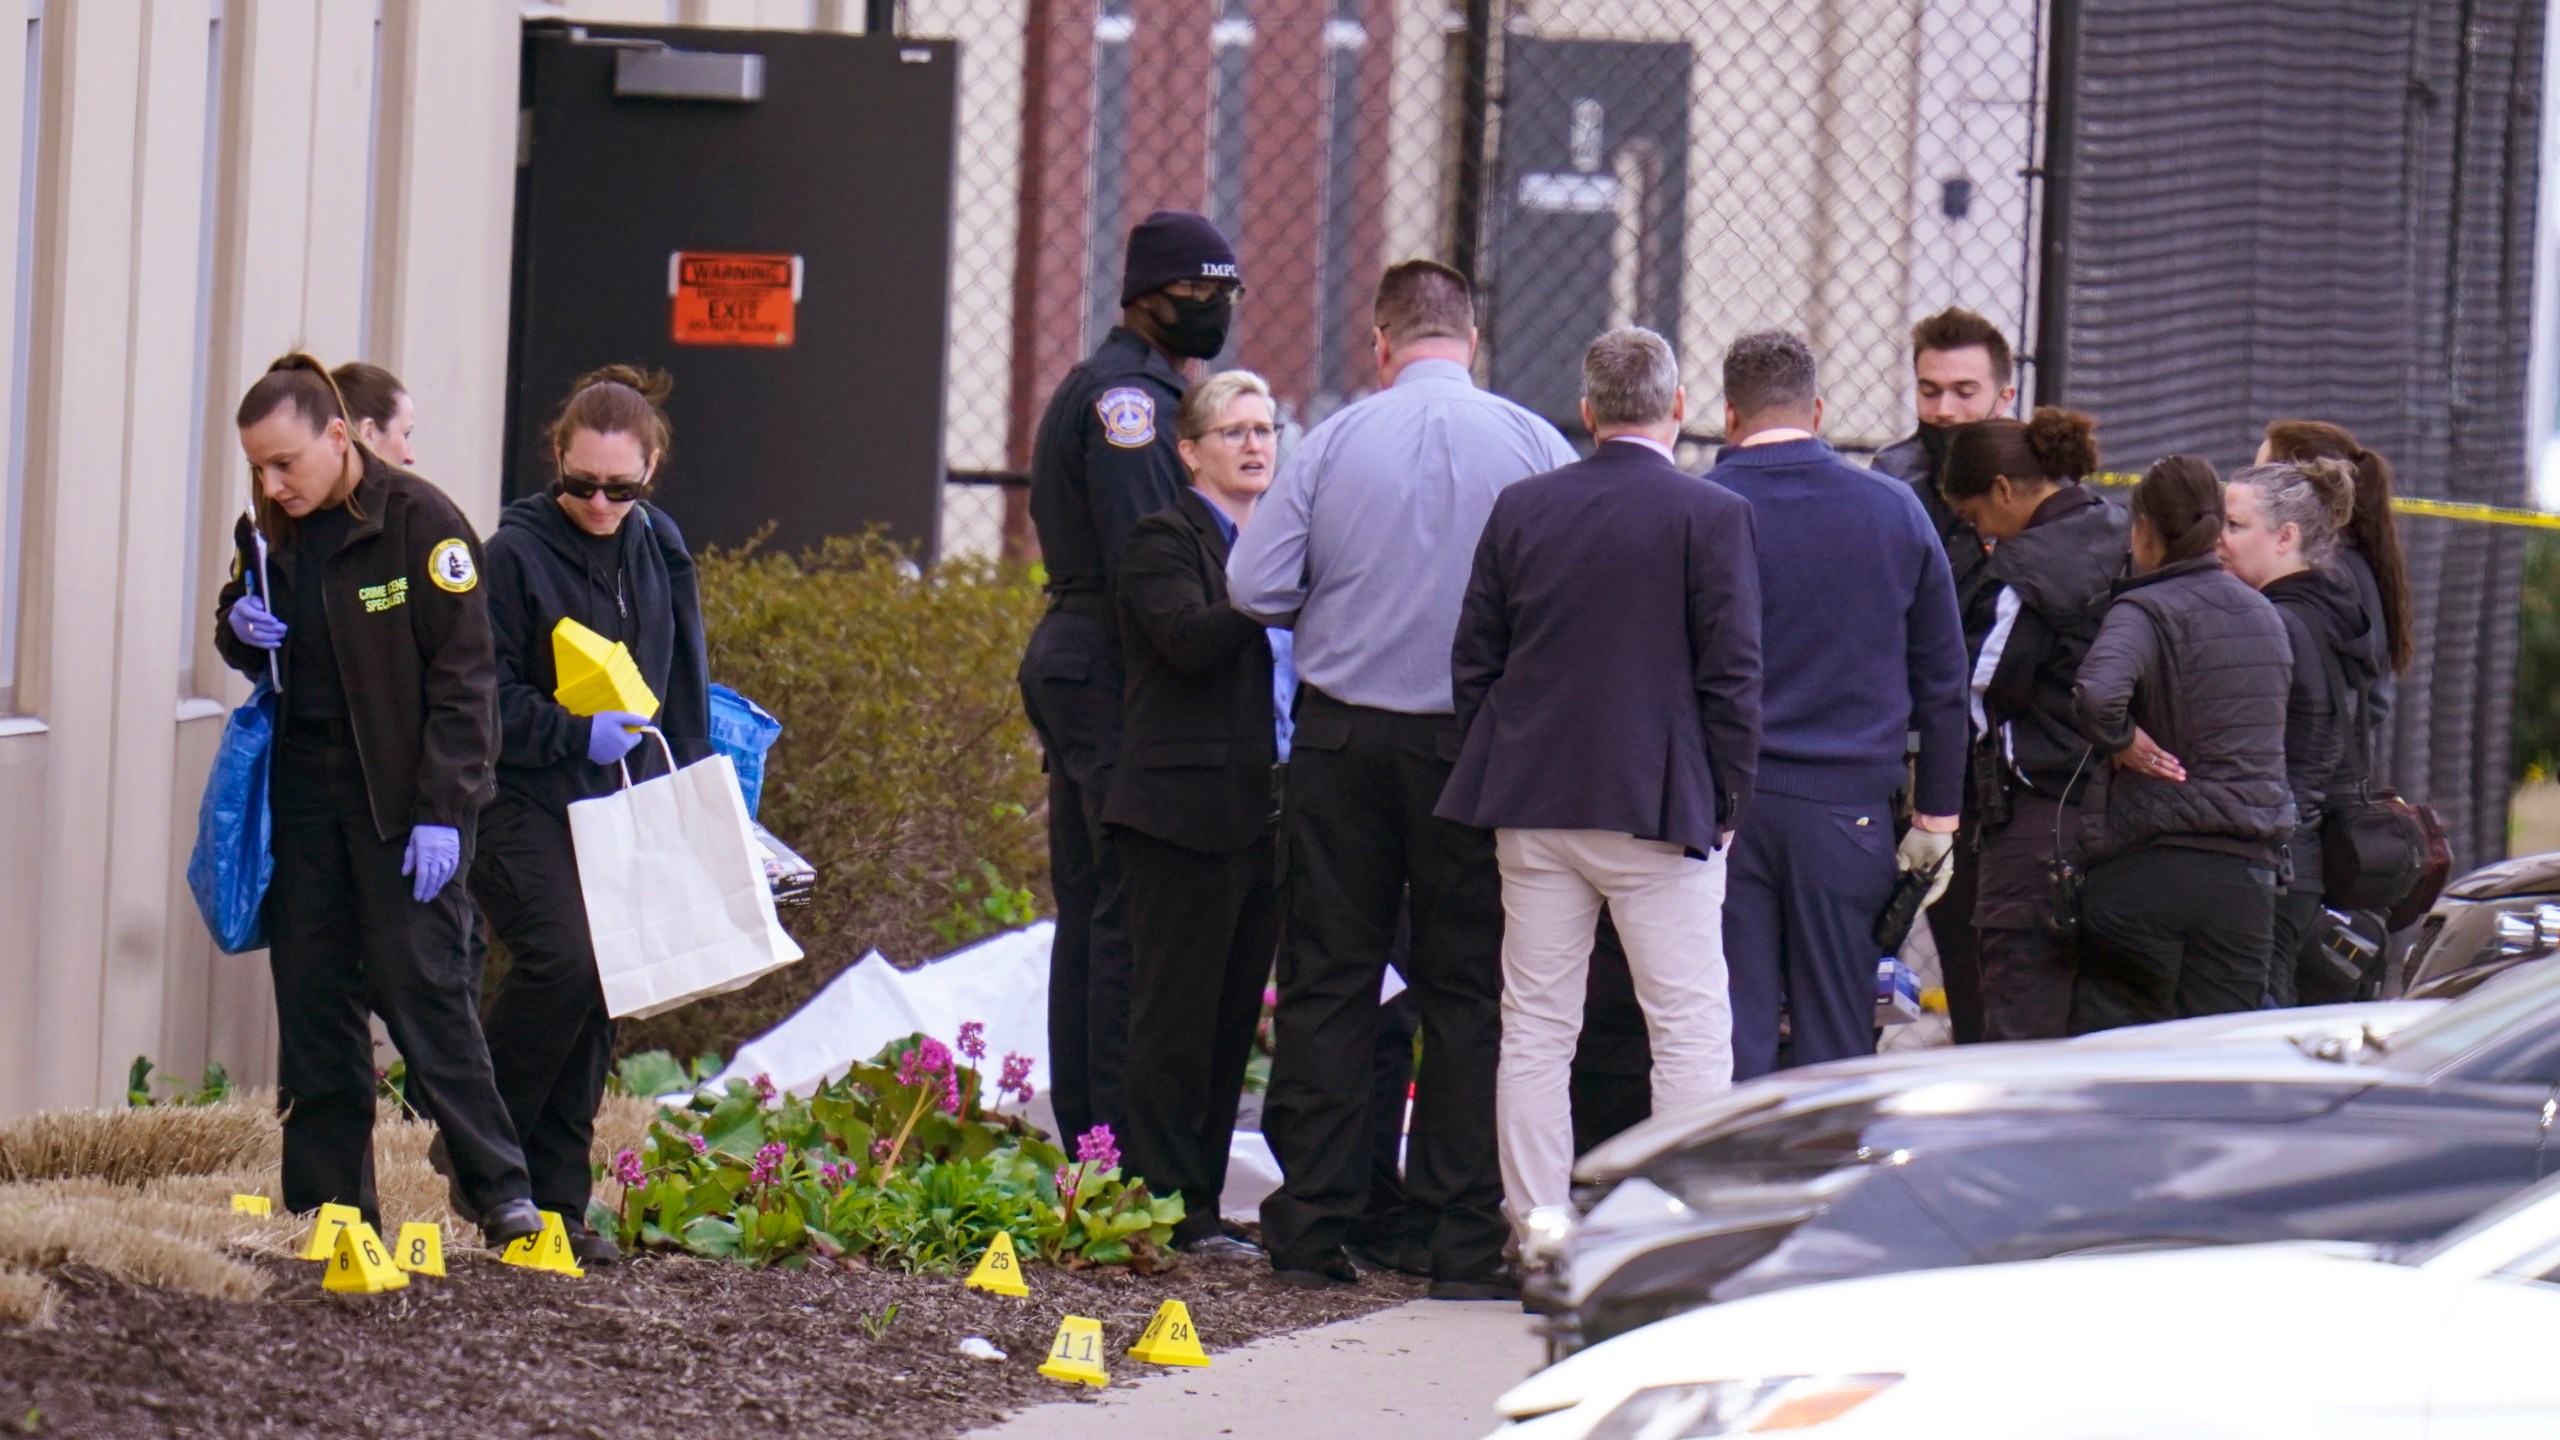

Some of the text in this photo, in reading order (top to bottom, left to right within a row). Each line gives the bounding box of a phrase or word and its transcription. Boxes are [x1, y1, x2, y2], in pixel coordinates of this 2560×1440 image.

[691, 263, 780, 281] WARNING
[708, 300, 759, 319] EXIT
[359, 584, 387, 601] CRIME
[331, 1219, 348, 1248] 7
[522, 1231, 540, 1252] 9
[362, 1240, 381, 1266] 6
[410, 1238, 426, 1265] 8
[554, 1234, 562, 1254] 9
[340, 1252, 349, 1271] 6
[991, 1251, 1009, 1270] 25
[1145, 1313, 1167, 1340] 24
[1170, 1322, 1188, 1341] 24
[1055, 1332, 1095, 1362] 11
